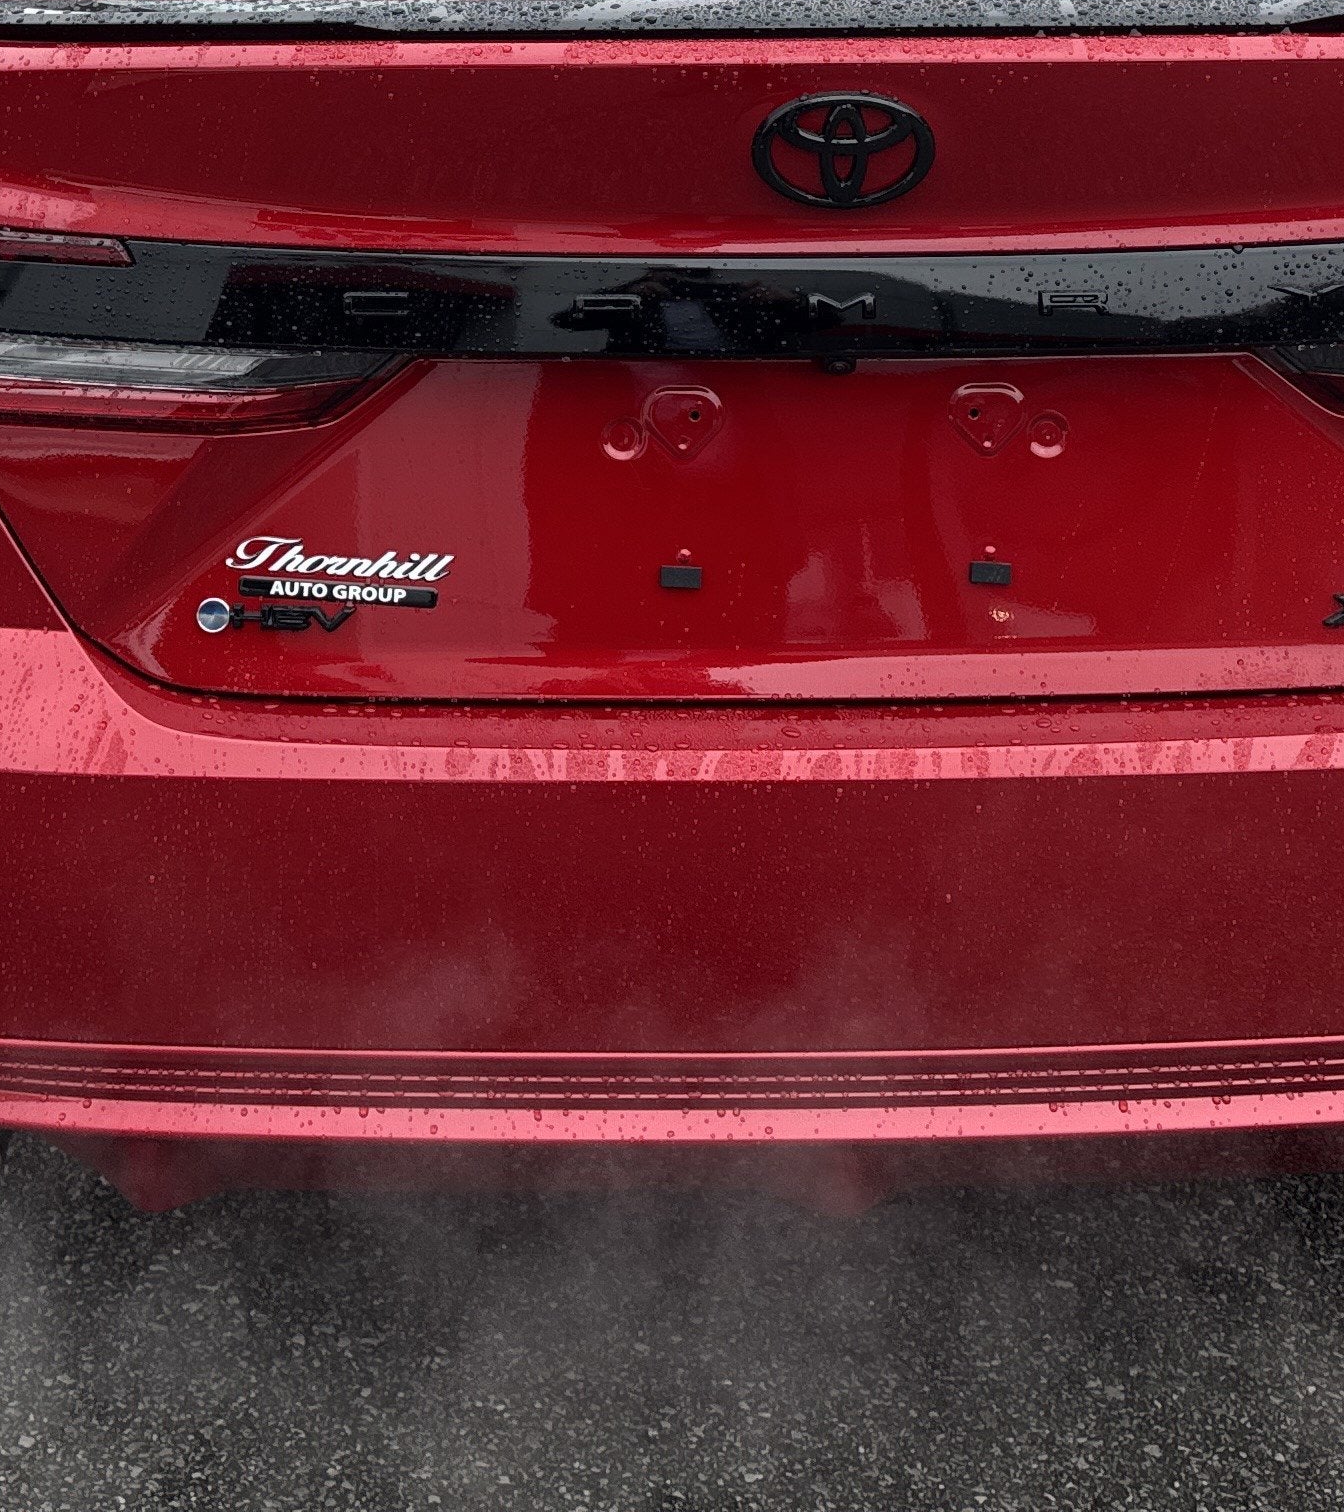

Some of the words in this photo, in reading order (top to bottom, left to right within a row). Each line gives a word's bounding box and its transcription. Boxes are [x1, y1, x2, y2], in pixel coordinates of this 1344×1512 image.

[226, 536, 455, 582] Thornhill
[269, 580, 328, 598] AUTO
[332, 583, 407, 604] GROUP
